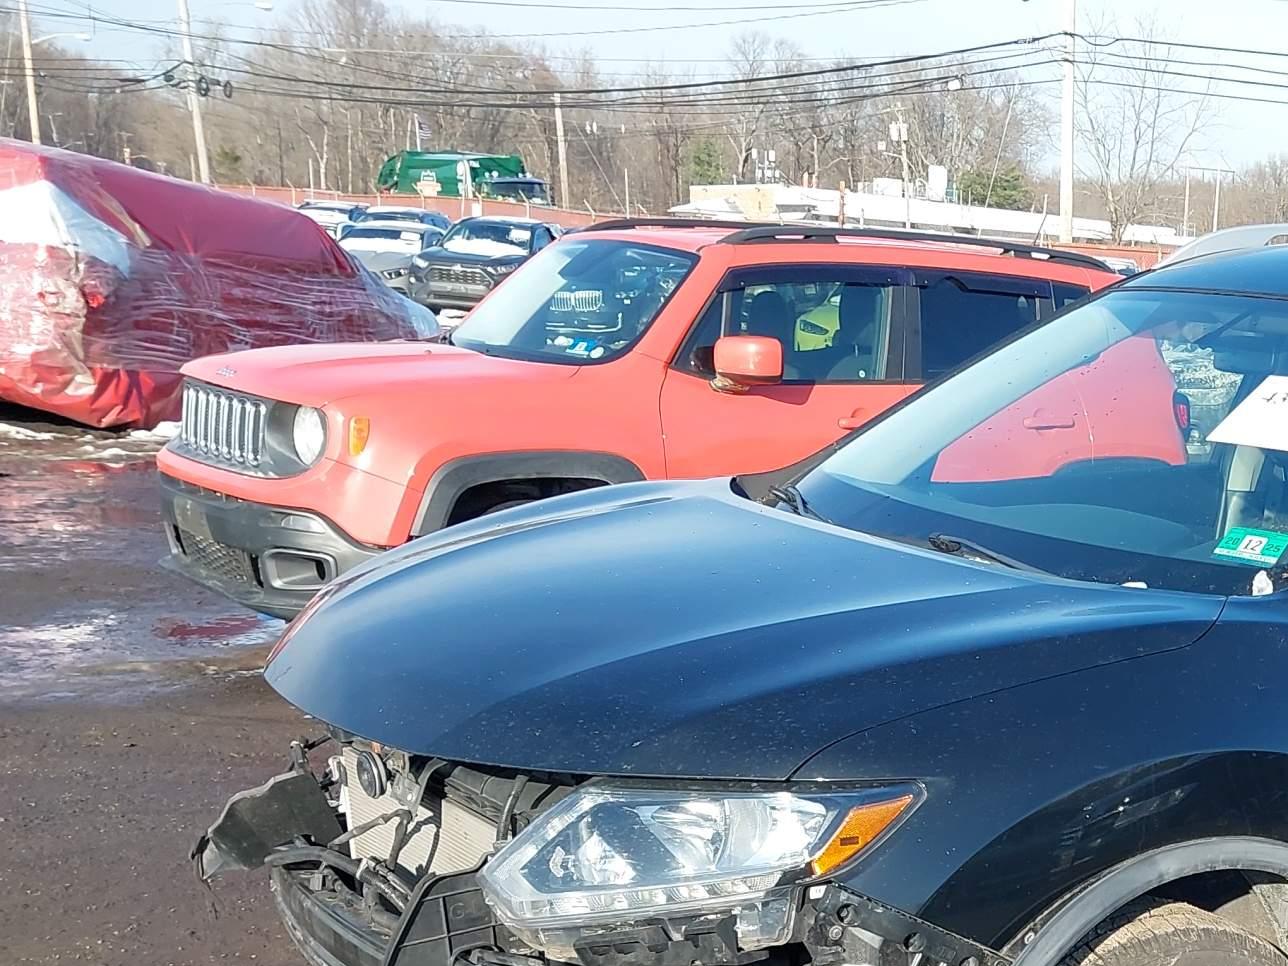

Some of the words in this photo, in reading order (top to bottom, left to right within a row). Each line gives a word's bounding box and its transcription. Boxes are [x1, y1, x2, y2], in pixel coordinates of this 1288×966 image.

[1224, 536, 1241, 546] 20
[1243, 538, 1263, 552] 12
[1265, 543, 1281, 553] 25
